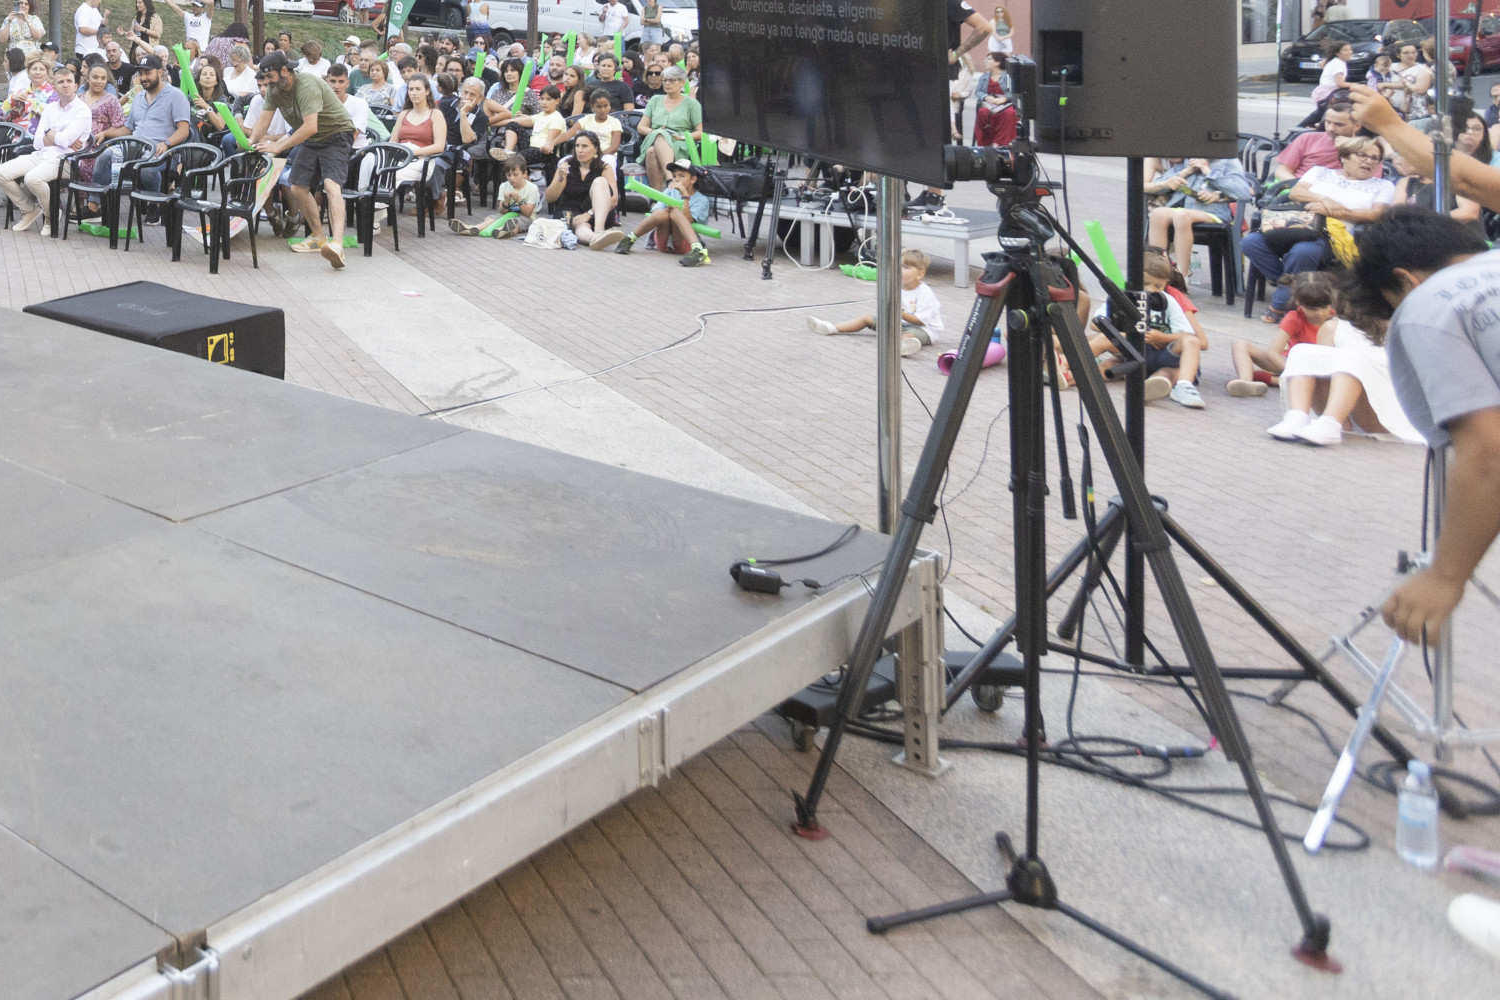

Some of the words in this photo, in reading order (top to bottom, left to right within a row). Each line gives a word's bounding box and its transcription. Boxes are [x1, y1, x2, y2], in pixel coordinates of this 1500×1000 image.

[788, 0, 836, 19] decídete,
[838, 1, 884, 22] elígeme
[706, 16, 714, 30] O
[715, 17, 746, 35] déjame
[748, 22, 766, 37] que
[767, 24, 778, 39] ya
[780, 25, 793, 37] no
[795, 23, 825, 44] tengo
[827, 27, 854, 43] nada
[856, 31, 879, 48] que
[882, 30, 924, 50] perder
